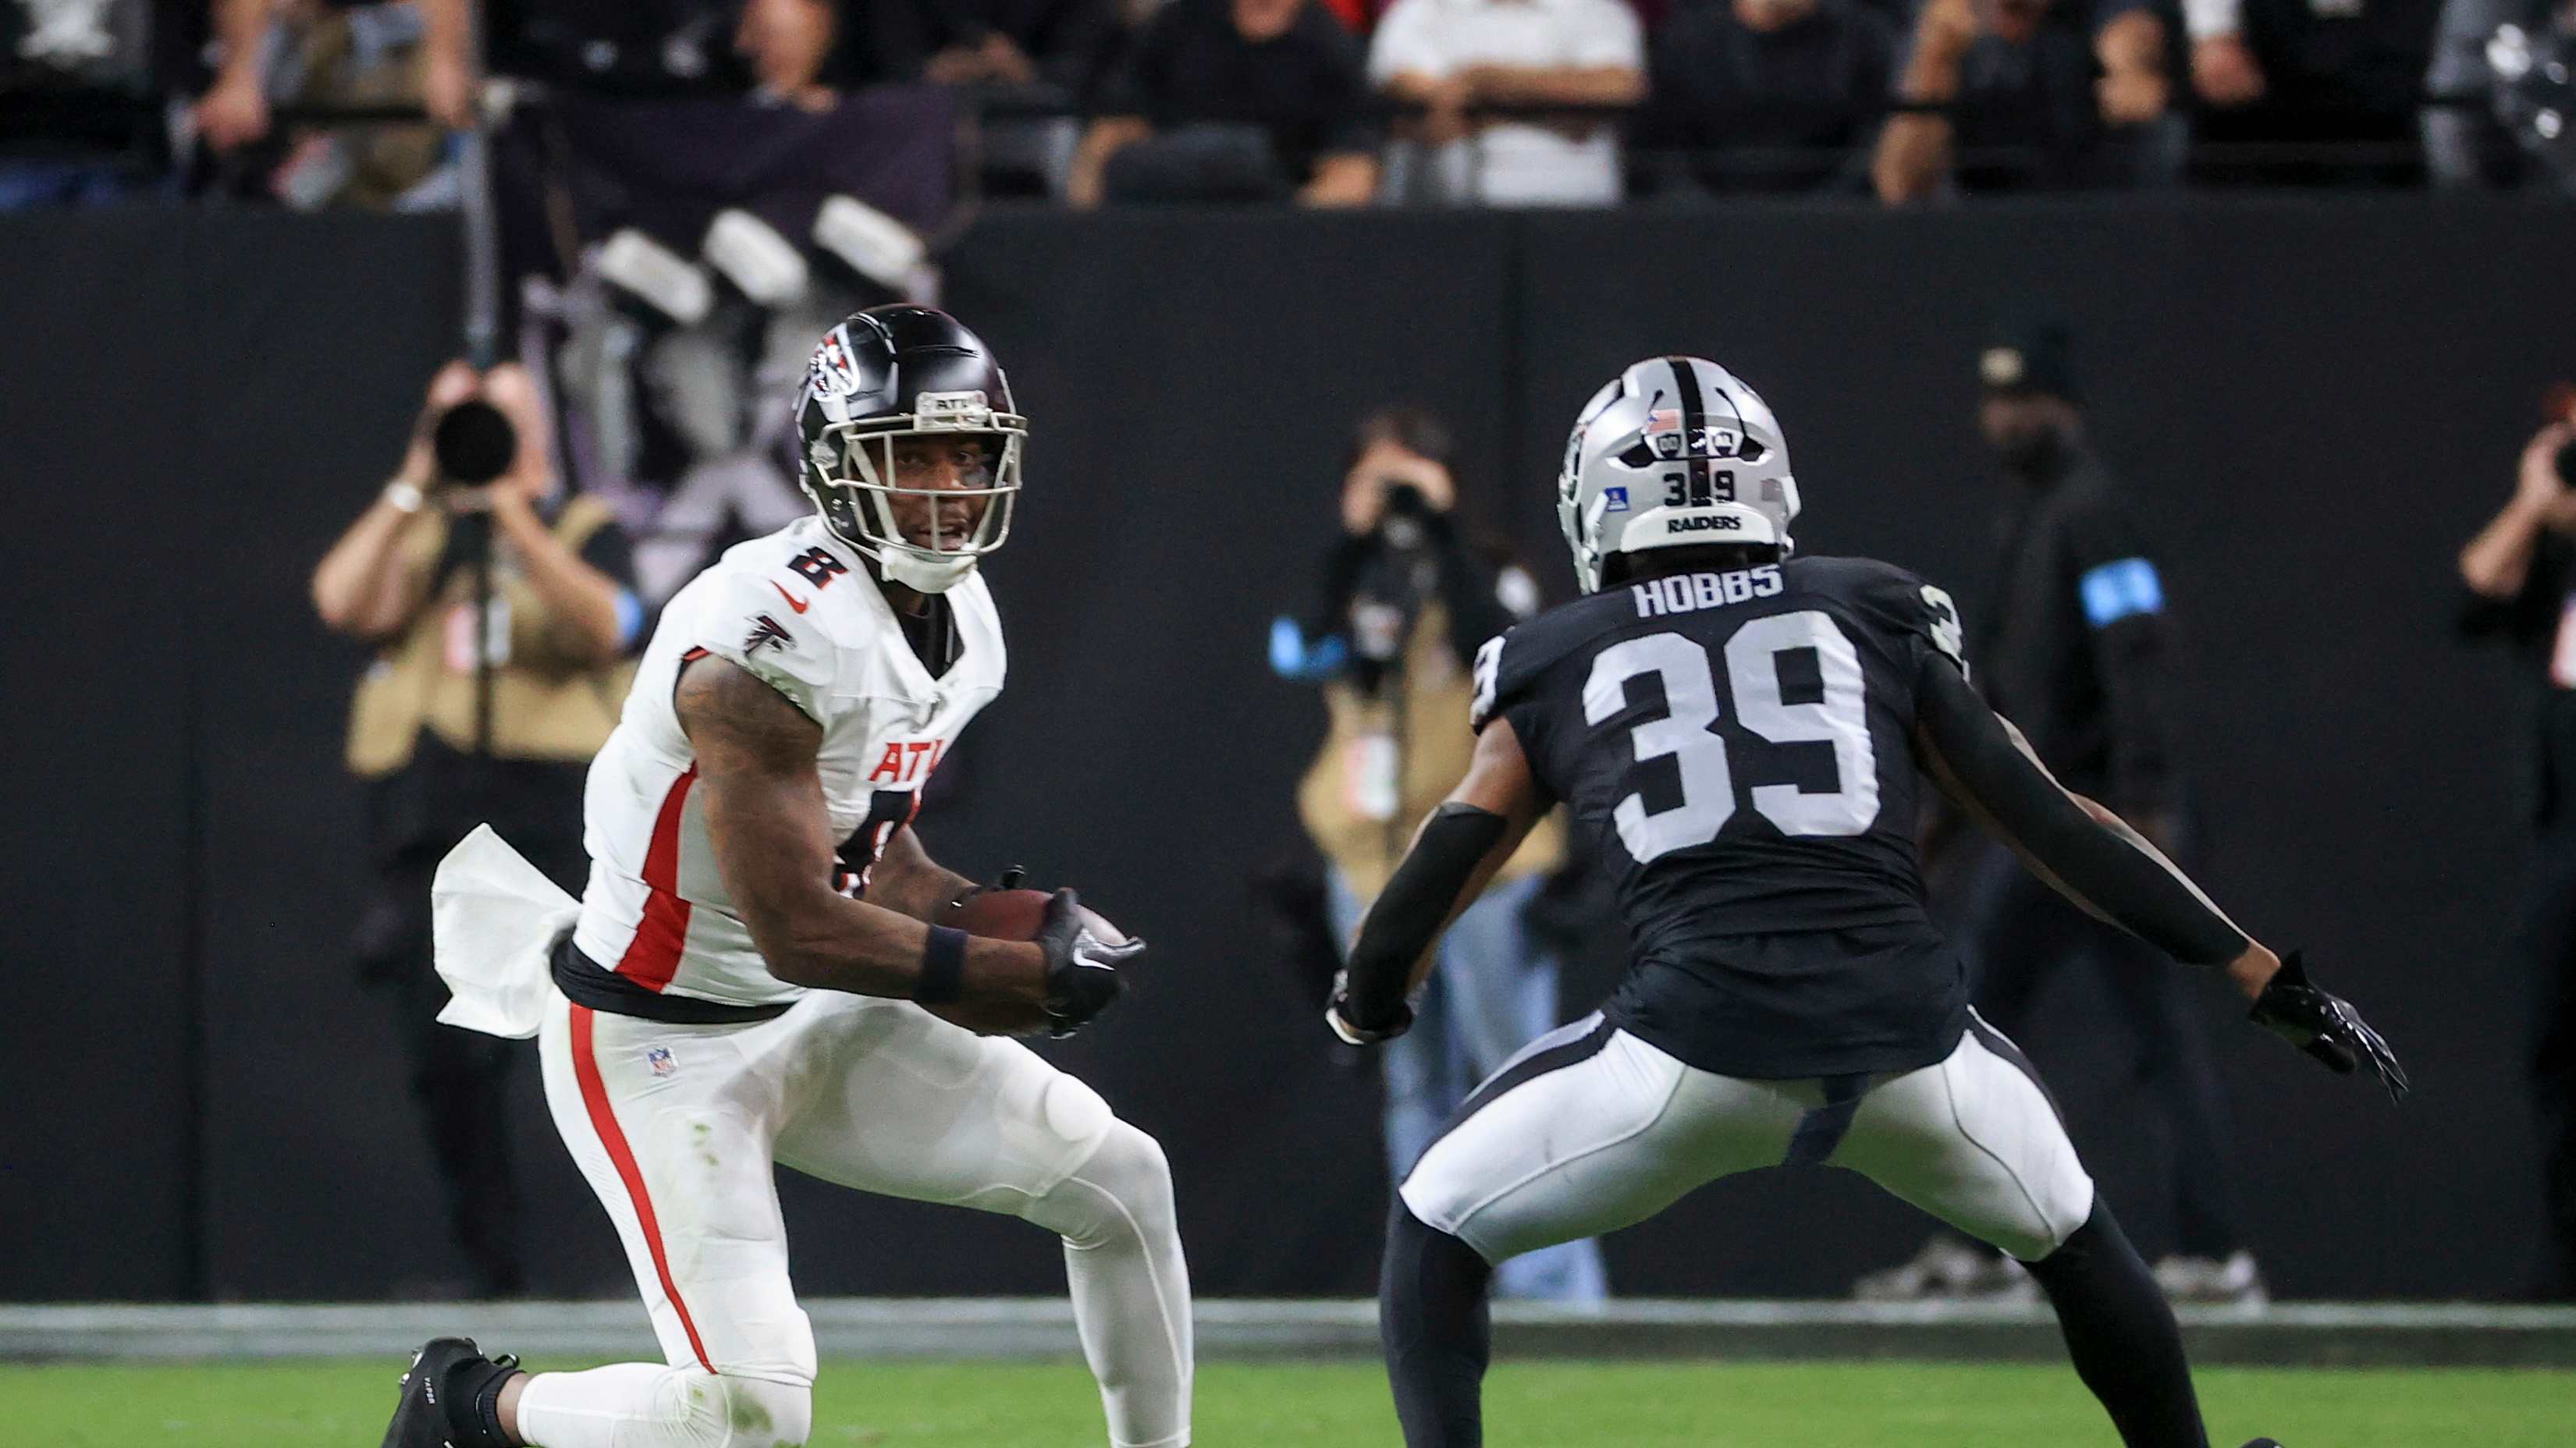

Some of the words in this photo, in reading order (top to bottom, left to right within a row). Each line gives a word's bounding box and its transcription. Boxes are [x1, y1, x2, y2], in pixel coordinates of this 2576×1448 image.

[1668, 516, 1741, 534] RAIDERS
[787, 546, 849, 591] 8
[1631, 563, 1784, 617] HOBBS
[1920, 584, 1971, 683] 3
[1582, 611, 1880, 864] 39
